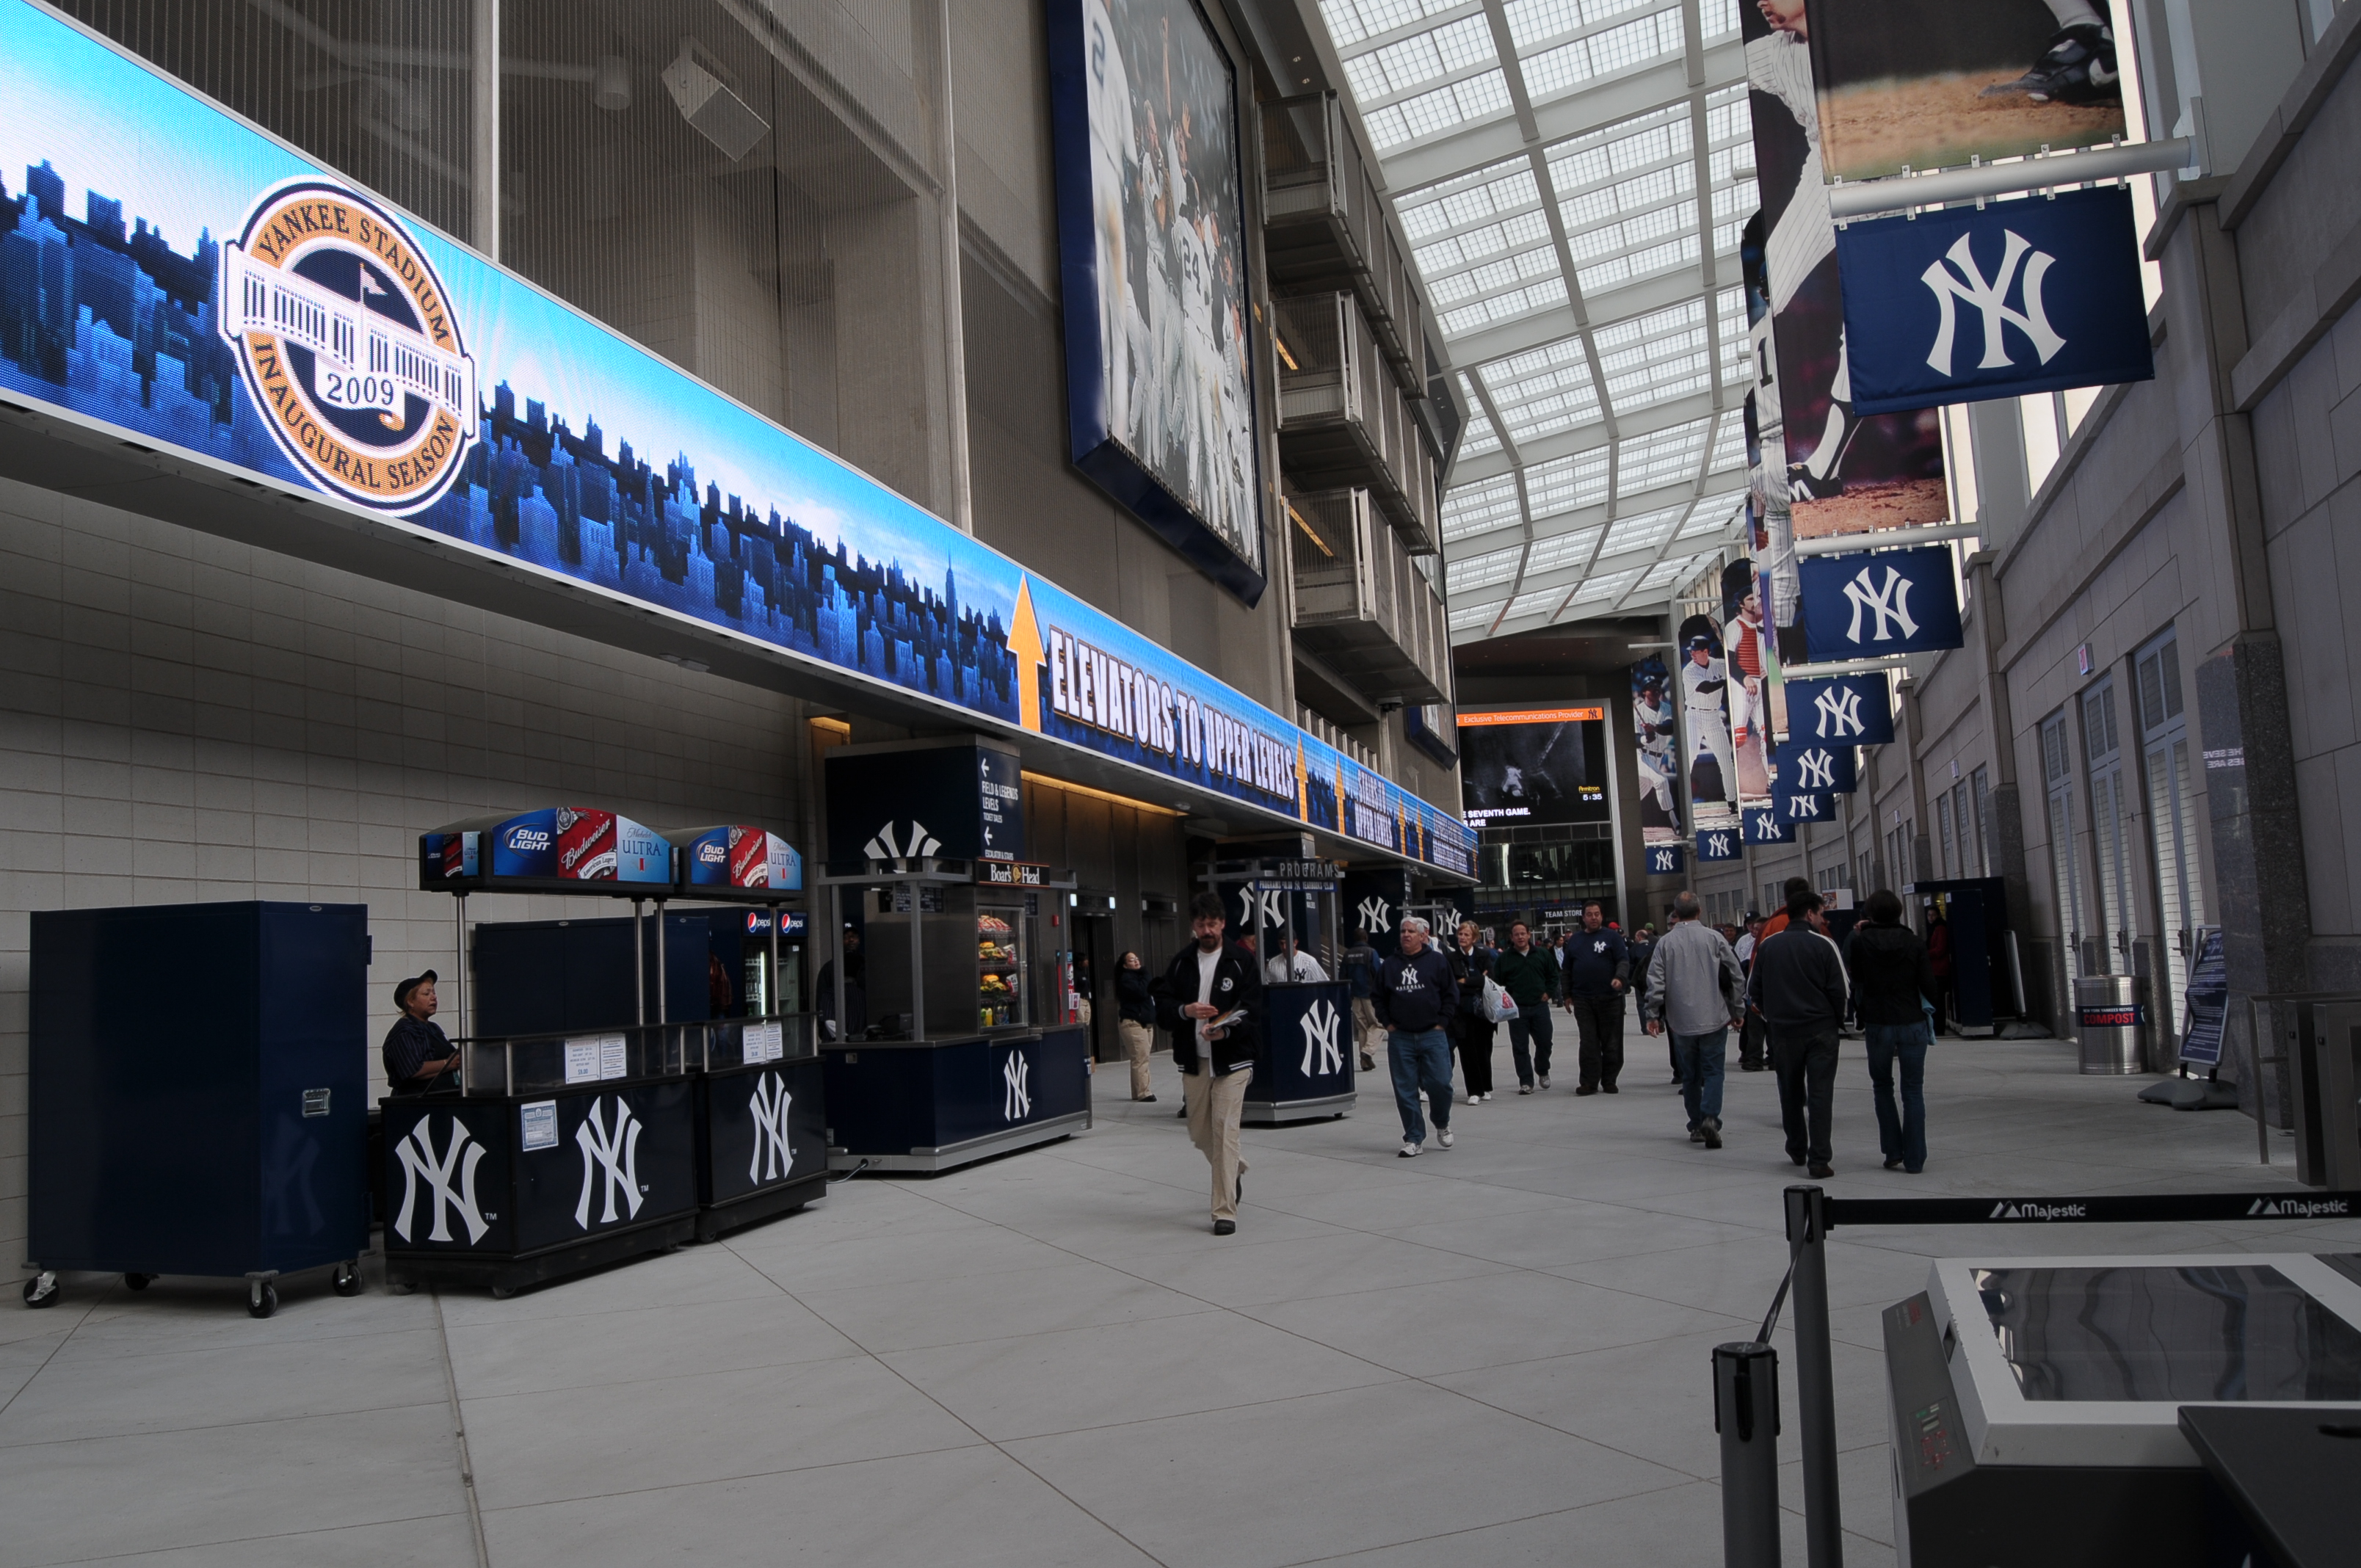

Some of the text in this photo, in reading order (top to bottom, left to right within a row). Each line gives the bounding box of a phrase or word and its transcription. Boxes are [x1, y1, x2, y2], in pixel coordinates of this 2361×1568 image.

[258, 203, 449, 342] YANKEE STADIUM
[1921, 229, 2066, 377] NY
[327, 374, 394, 406] 2009
[255, 343, 454, 490] INAUGURAL SEASON
[1843, 565, 1919, 645] NY
[1049, 624, 1295, 803] ELEVATORS TO UPPER LEVELS
[1464, 715, 1493, 723] Exclusive
[1493, 713, 1557, 722] Telecommunications
[1558, 711, 1584, 719] Provider
[1814, 686, 1865, 738] NY
[982, 780, 1018, 800] FIELD & LEGENDS
[982, 796, 999, 811] LEVELS
[1468, 809, 1504, 818] SEVENTH
[1505, 807, 1531, 816] GAME.
[1469, 819, 1487, 827] ARE
[516, 830, 548, 841] BUD
[561, 818, 611, 869] Budweiser
[509, 840, 551, 851] LIGHT
[623, 840, 662, 856] ULTRA
[703, 844, 725, 854] BUD
[700, 853, 726, 863] LIGHT
[732, 835, 763, 879] Budweiser
[770, 852, 796, 867] ULTRA
[990, 864, 1040, 885] Boar's Head
[1280, 862, 1339, 877] PROGRAMS
[790, 918, 803, 929] pepsi
[1358, 896, 1390, 933] NY
[1545, 910, 1563, 918] TEAM
[1401, 967, 1418, 985] NY
[2084, 1012, 2135, 1024] COMPOST
[1300, 998, 1343, 1078] NY
[1003, 1050, 1031, 1122] NY
[749, 1071, 794, 1186] NY
[575, 1095, 644, 1230] NY
[394, 1114, 490, 1246] NY
[2021, 1203, 2086, 1221] Majestic
[2280, 1199, 2349, 1218] Majestic
